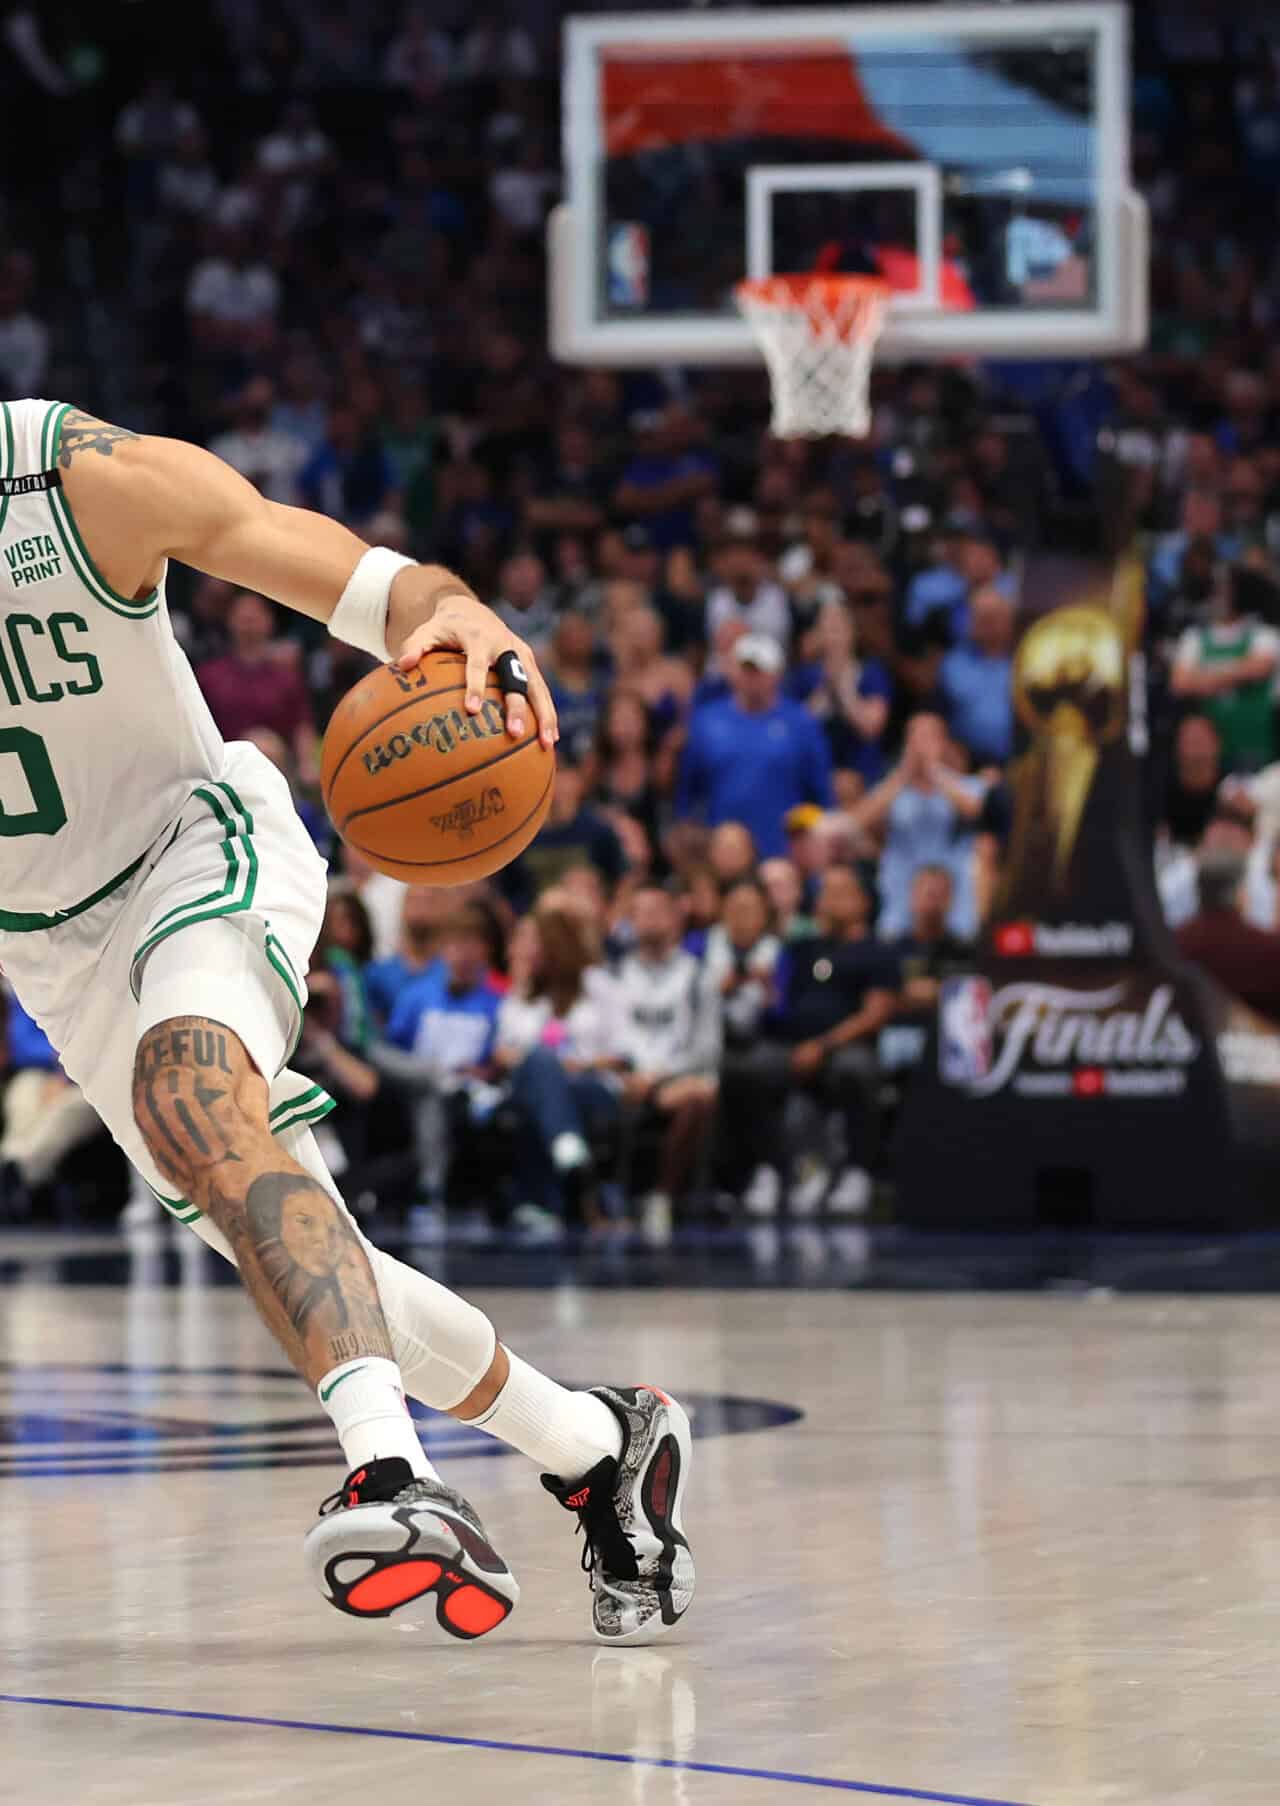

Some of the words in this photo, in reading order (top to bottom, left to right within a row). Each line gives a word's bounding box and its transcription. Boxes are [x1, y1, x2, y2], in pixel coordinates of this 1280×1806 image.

[4, 535, 58, 569] VISTA
[11, 557, 62, 587] PRINT
[362, 698, 507, 776] Wilson
[971, 980, 1198, 1097] Finals
